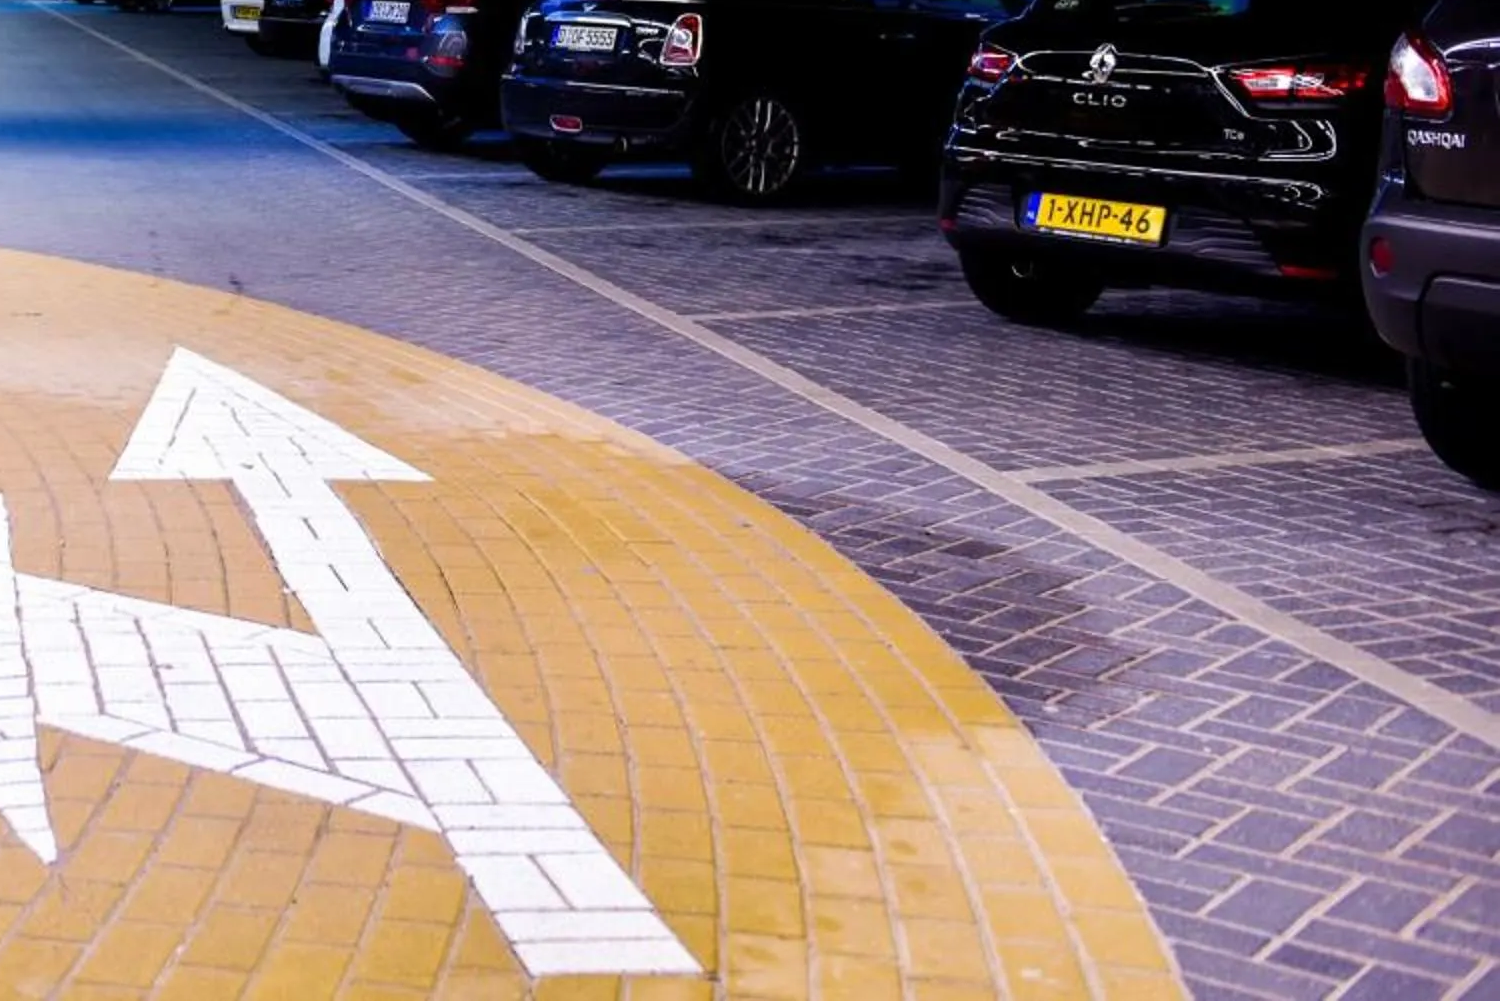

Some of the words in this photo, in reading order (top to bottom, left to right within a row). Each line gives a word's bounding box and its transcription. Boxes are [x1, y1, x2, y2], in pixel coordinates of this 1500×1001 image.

[1072, 92, 1127, 108] CLIO
[1407, 129, 1466, 150] QASHQAI
[1047, 198, 1151, 234] 1-XHP-46
